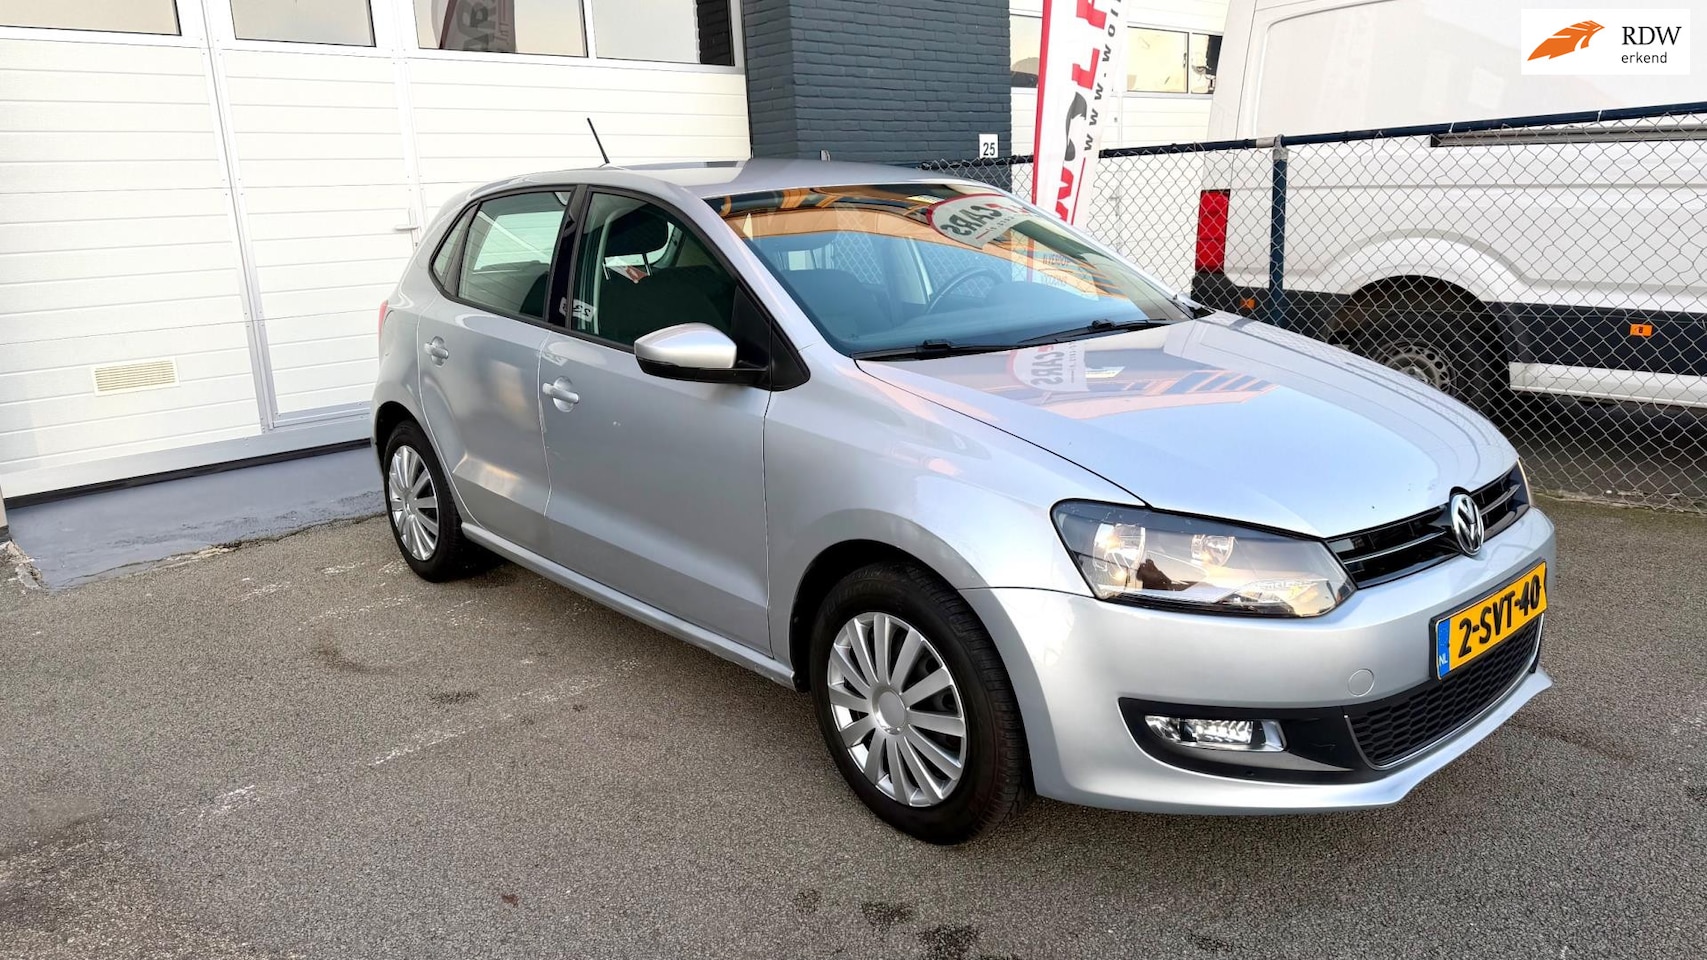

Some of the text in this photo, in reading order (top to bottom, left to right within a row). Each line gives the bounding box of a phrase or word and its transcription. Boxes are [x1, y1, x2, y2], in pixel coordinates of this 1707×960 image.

[983, 142, 996, 156] 25
[1458, 574, 1541, 658] 2-SVT-40
[1438, 653, 1448, 667] NL
